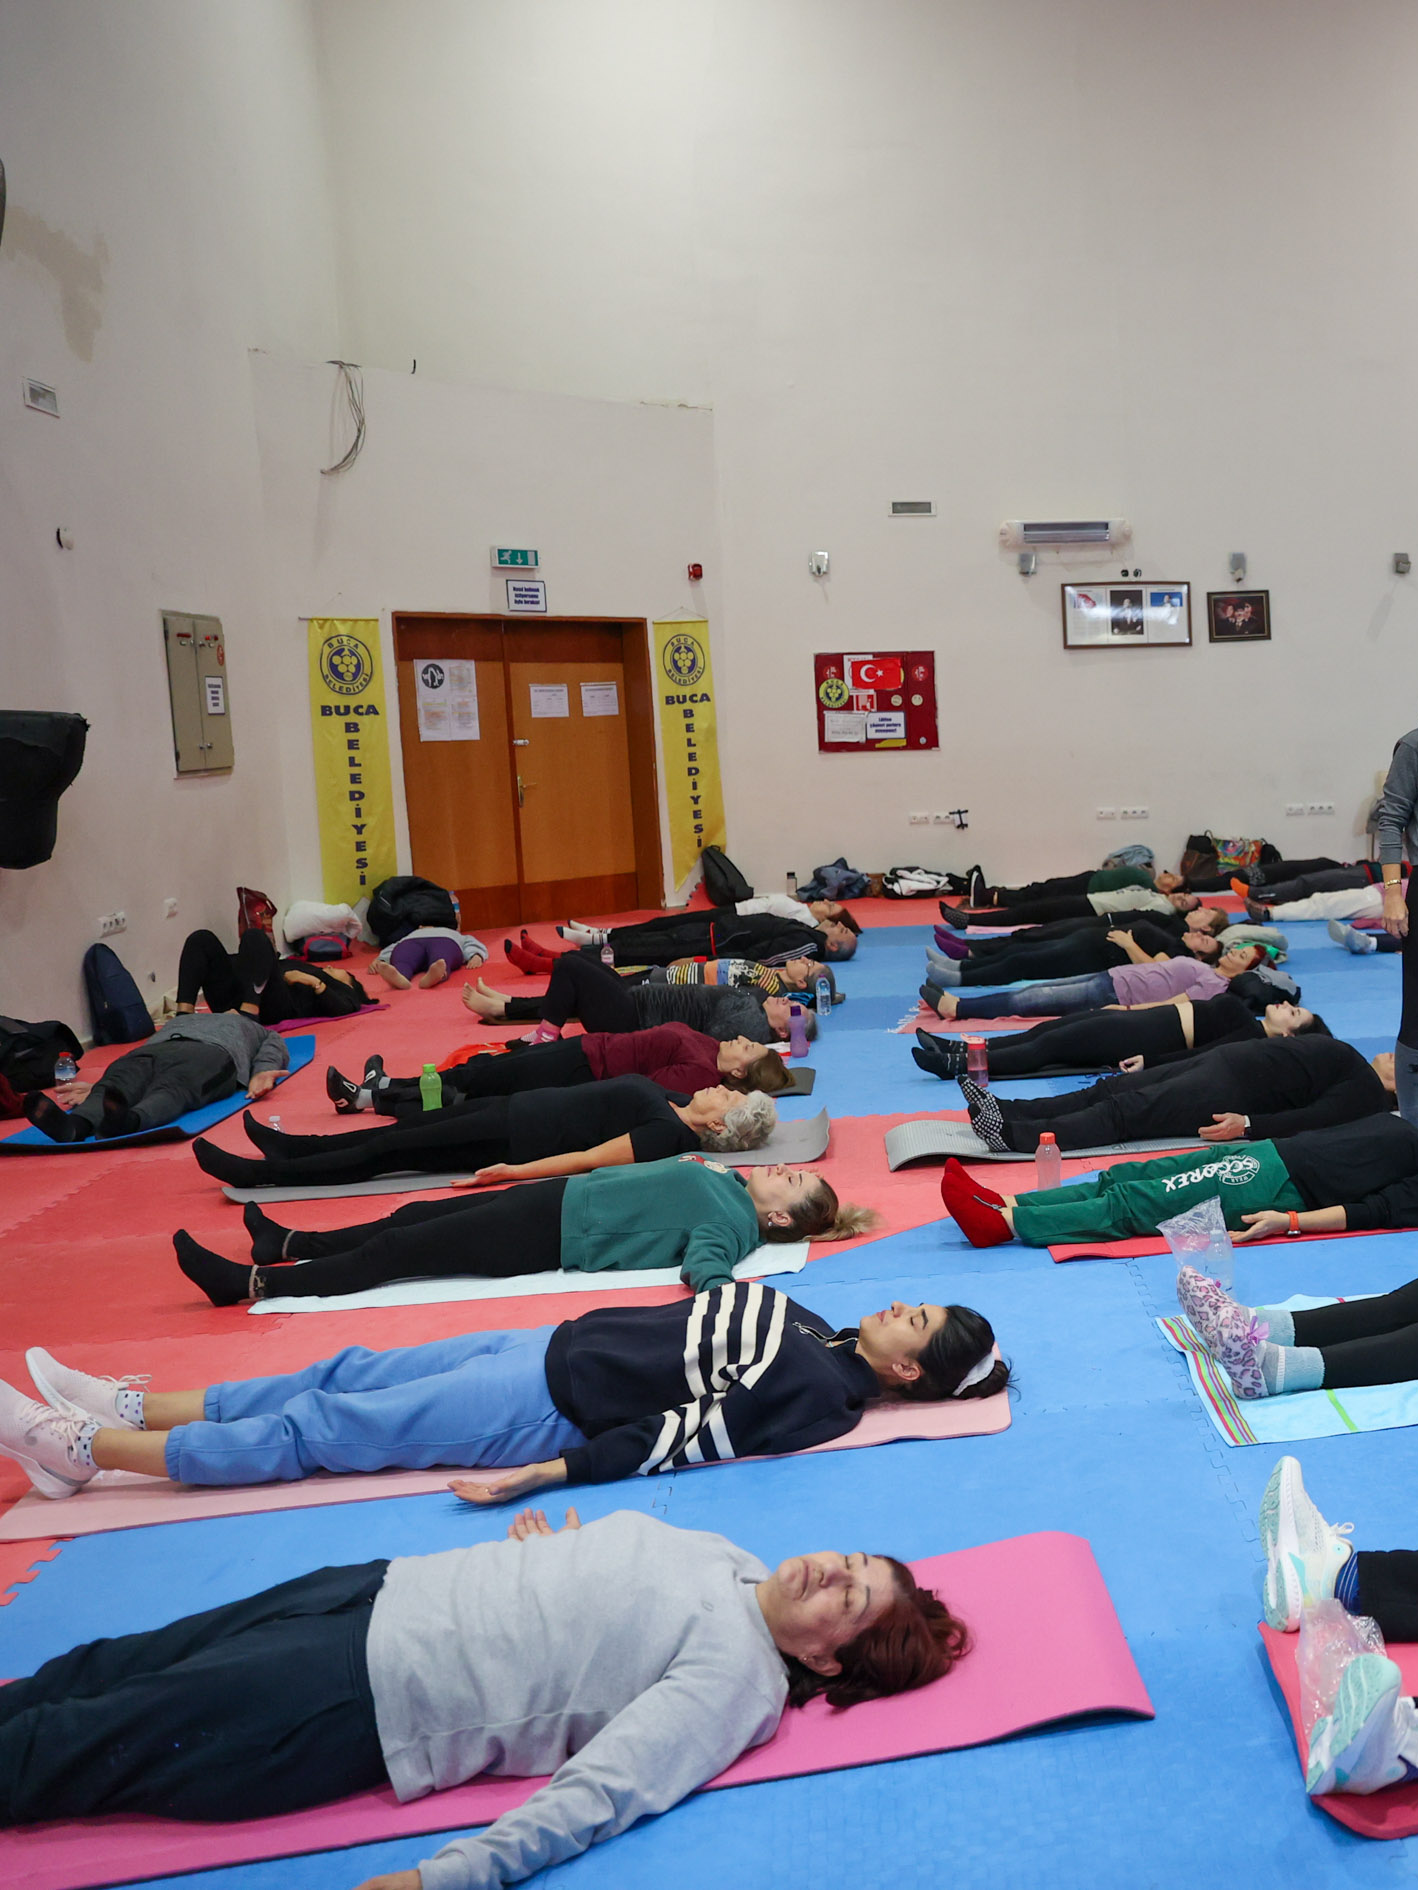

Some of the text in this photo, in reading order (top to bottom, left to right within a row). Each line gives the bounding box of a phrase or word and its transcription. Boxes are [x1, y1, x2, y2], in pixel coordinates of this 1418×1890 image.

[327, 638, 359, 650] BUCA
[665, 692, 711, 706] BUCA
[320, 704, 380, 717] BUCA
[683, 708, 704, 848] BELEDİYESİ
[344, 721, 369, 886] BELEDİYESİ
